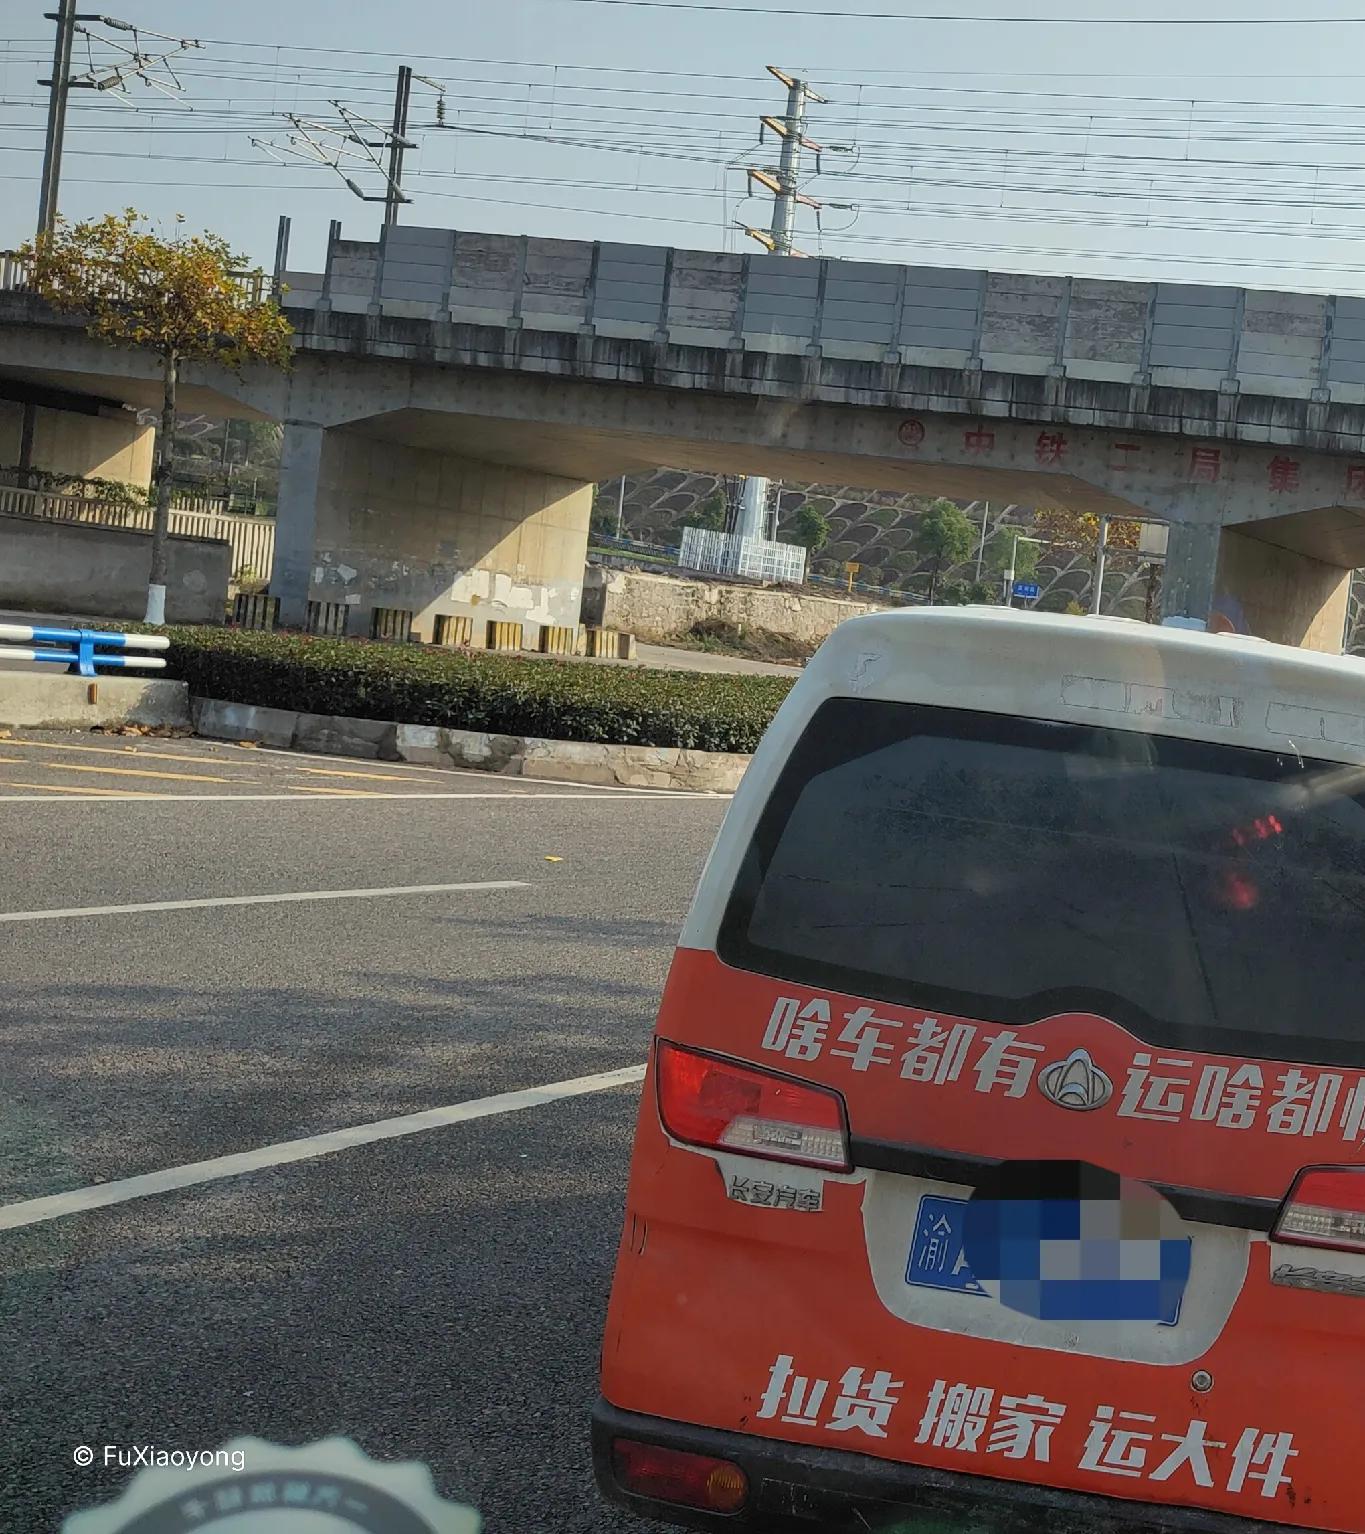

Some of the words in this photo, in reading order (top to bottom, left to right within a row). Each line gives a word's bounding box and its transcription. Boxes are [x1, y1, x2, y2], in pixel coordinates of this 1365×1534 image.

[762, 996, 1045, 1099] 啥车都有
[731, 1174, 821, 1211] 长安汽车
[914, 1379, 1067, 1464] 搬家
[1078, 1405, 1300, 1498] 运大件
